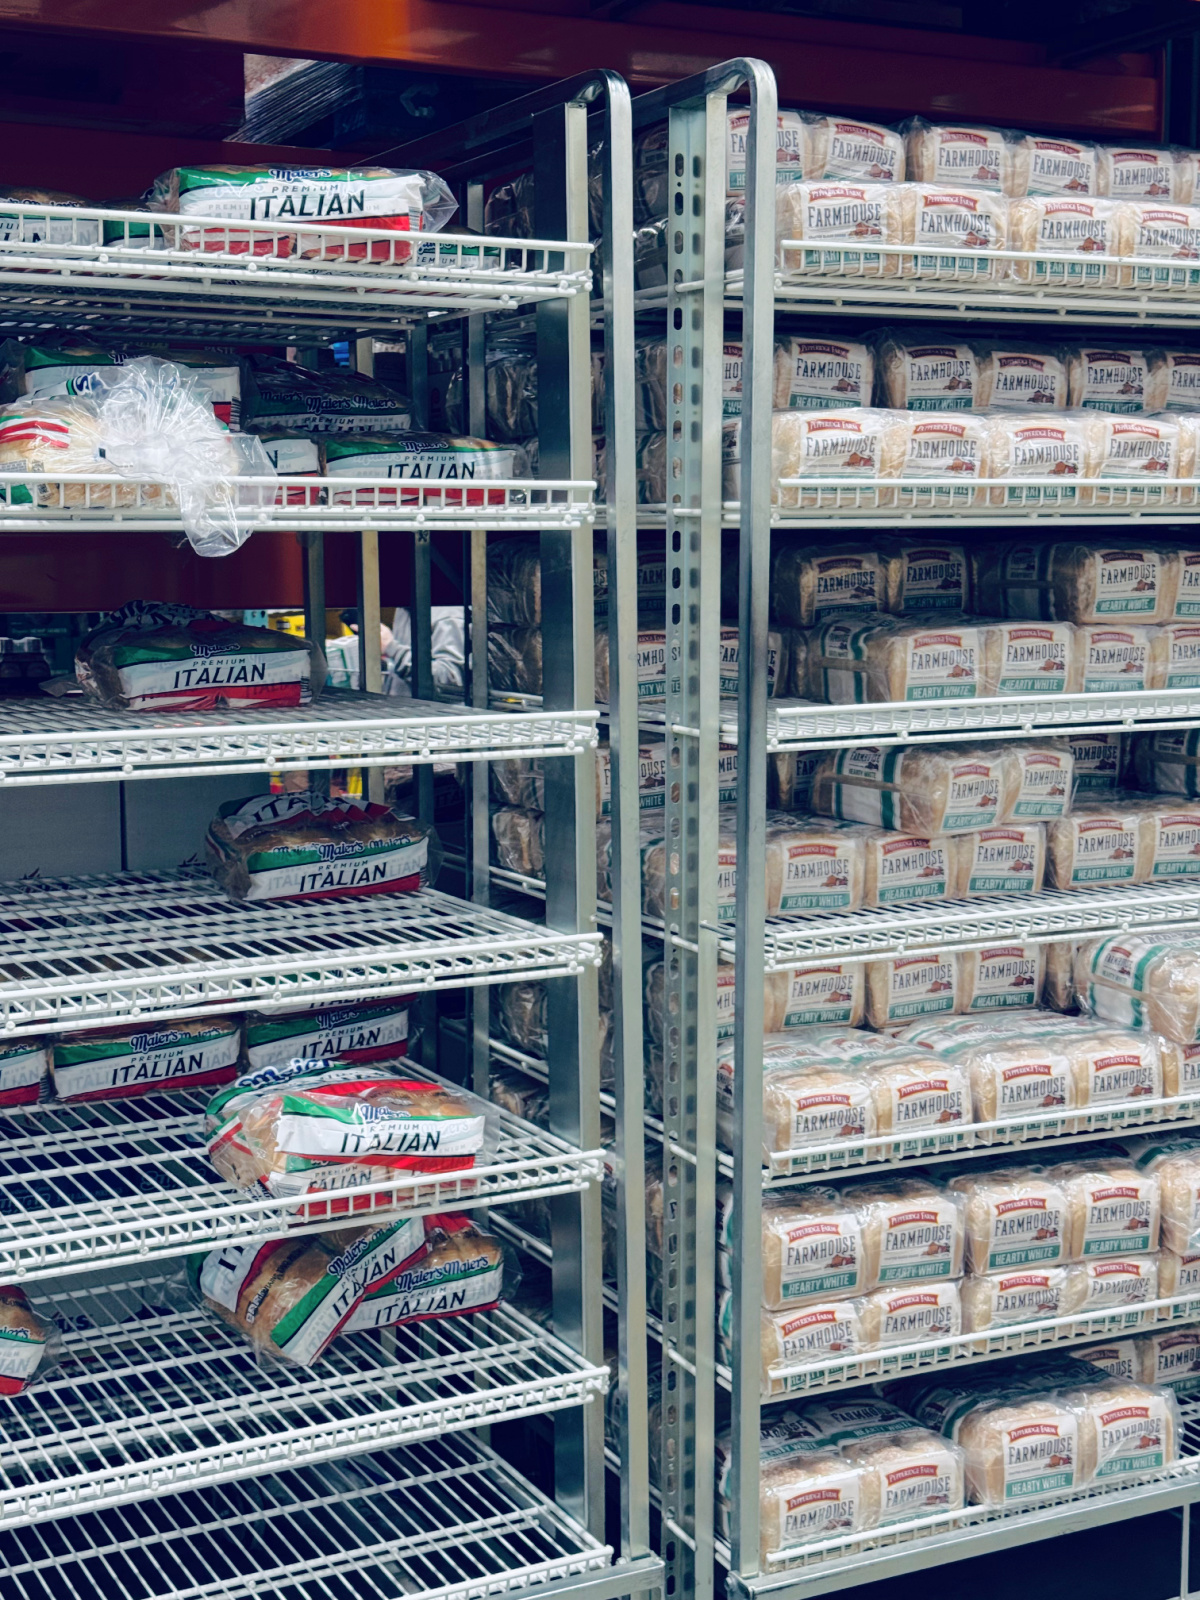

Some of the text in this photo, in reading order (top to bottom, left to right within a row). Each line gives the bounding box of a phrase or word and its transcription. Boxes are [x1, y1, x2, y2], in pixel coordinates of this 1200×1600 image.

[831, 137, 896, 166] FARMHOUSE
[939, 149, 999, 167] FARMHOUSE
[1033, 155, 1091, 180] FARMHOUSE
[1113, 167, 1170, 186] FARMHOUSE
[271, 183, 338, 195] PREMIUM
[250, 189, 364, 221] ITALIAN
[808, 203, 881, 227] FARMHOUSE
[922, 213, 990, 233] FARMHOUSE
[1041, 219, 1106, 240] FARMHOUSE
[797, 359, 861, 380] FARMHOUSE
[911, 360, 971, 380] FARMHOUSE
[1087, 367, 1144, 385] FARMHOUSE
[996, 372, 1056, 391] FARMHOUSE
[1086, 402, 1113, 413] HEARTY
[304, 417, 355, 425] PREMIUM
[806, 435, 877, 457] FARMHOUSE
[910, 439, 976, 459] FARMHOUSE
[1014, 445, 1079, 466] FARMHOUSE
[1109, 439, 1171, 459] FARMHOUSE
[388, 462, 475, 480] ITALIAN
[818, 571, 875, 593] FARMHOUSE
[907, 563, 961, 582] FARMHOUSE
[1101, 564, 1156, 585] FARMHOUSE
[1101, 600, 1149, 611] HEARTY WHITE
[193, 658, 246, 667] PREMIUM
[911, 648, 974, 670] FARMHOUSE
[1007, 643, 1065, 662] FARMHOUSE
[1090, 647, 1145, 664] FARMHOUSE
[173, 663, 266, 689] ITALIAN
[1005, 679, 1058, 690] HEARTY WHITE
[913, 685, 970, 698] HEARTY WHITE
[1024, 769, 1068, 787] FARMHOUSE
[951, 779, 998, 800] FARMHOUSE
[319, 841, 364, 861] Maier's
[1078, 832, 1134, 853] FARMHOUSE
[882, 850, 943, 875] FARMHOUSE
[978, 845, 1035, 862] FARMHOUSE
[318, 860, 369, 871] PREMIUM
[788, 859, 849, 880] FARMHOUSE
[1078, 867, 1128, 879] HEARTY WHITE
[300, 861, 386, 892] ITALIAN
[976, 879, 1027, 890] HEARTY WHITE
[885, 884, 939, 899] HEARTY WHITE
[788, 896, 843, 908] HEARTY WHITE
[893, 964, 952, 990] FARMHOUSE
[979, 960, 1035, 981] FARMHOUSE
[792, 975, 853, 998] FARMHOUSE
[895, 1000, 947, 1016] HEARTY WHITE
[977, 993, 1028, 1006] HEARTY WHITE
[790, 1009, 845, 1024] HEARTY WHITE
[130, 1030, 179, 1053] Maier's
[318, 1025, 364, 1039] PREMIUM
[302, 1028, 381, 1059] ITALIAN
[131, 1050, 184, 1063] PREMIUM
[111, 1052, 203, 1086] ITALIAN
[1002, 1076, 1065, 1103] FARMHOUSE
[1093, 1067, 1153, 1093] FARMHOUSE
[897, 1092, 961, 1121] FARMHOUSE
[796, 1107, 865, 1133] FARMHOUSE
[340, 1131, 441, 1153] ITALIAN
[920, 1211, 936, 1222] FARM
[1090, 1201, 1150, 1224] FARMHOUSE
[821, 1224, 837, 1234] FARM
[995, 1211, 1060, 1236] FARMHOUSE
[886, 1225, 952, 1250] FARMHOUSE
[1090, 1237, 1143, 1252] HEARTY WHITE
[327, 1237, 369, 1277] Maier's
[787, 1235, 855, 1265] FARMHOUSE
[995, 1248, 1054, 1265] HEARTY WHITE
[396, 1256, 490, 1292] Maier's Maier's
[886, 1263, 943, 1279] HEARTY WHITE
[332, 1246, 396, 1318] ITALIAN
[789, 1275, 849, 1293] HEARTY WHITE
[395, 1286, 447, 1302] PREMIUM
[997, 1288, 1061, 1312] FARMHOUSE
[375, 1289, 466, 1325] ITALIAN
[817, 1310, 836, 1323] FARM
[886, 1306, 952, 1333] FARMHOUSE
[783, 1321, 853, 1358] FARMHOUSE
[1132, 1407, 1148, 1418] FARM
[1040, 1424, 1057, 1435] FARM
[1102, 1418, 1161, 1448] FARMHOUSE
[1009, 1437, 1072, 1465] FARMHOUSE
[920, 1465, 936, 1476] FARM
[1102, 1456, 1156, 1472] HEARTY WHITE
[821, 1489, 839, 1500] FARM
[886, 1476, 950, 1507] FARMHOUSE
[1012, 1475, 1067, 1494] HEARTY WHITE
[785, 1501, 854, 1532] FARMHOUSE
